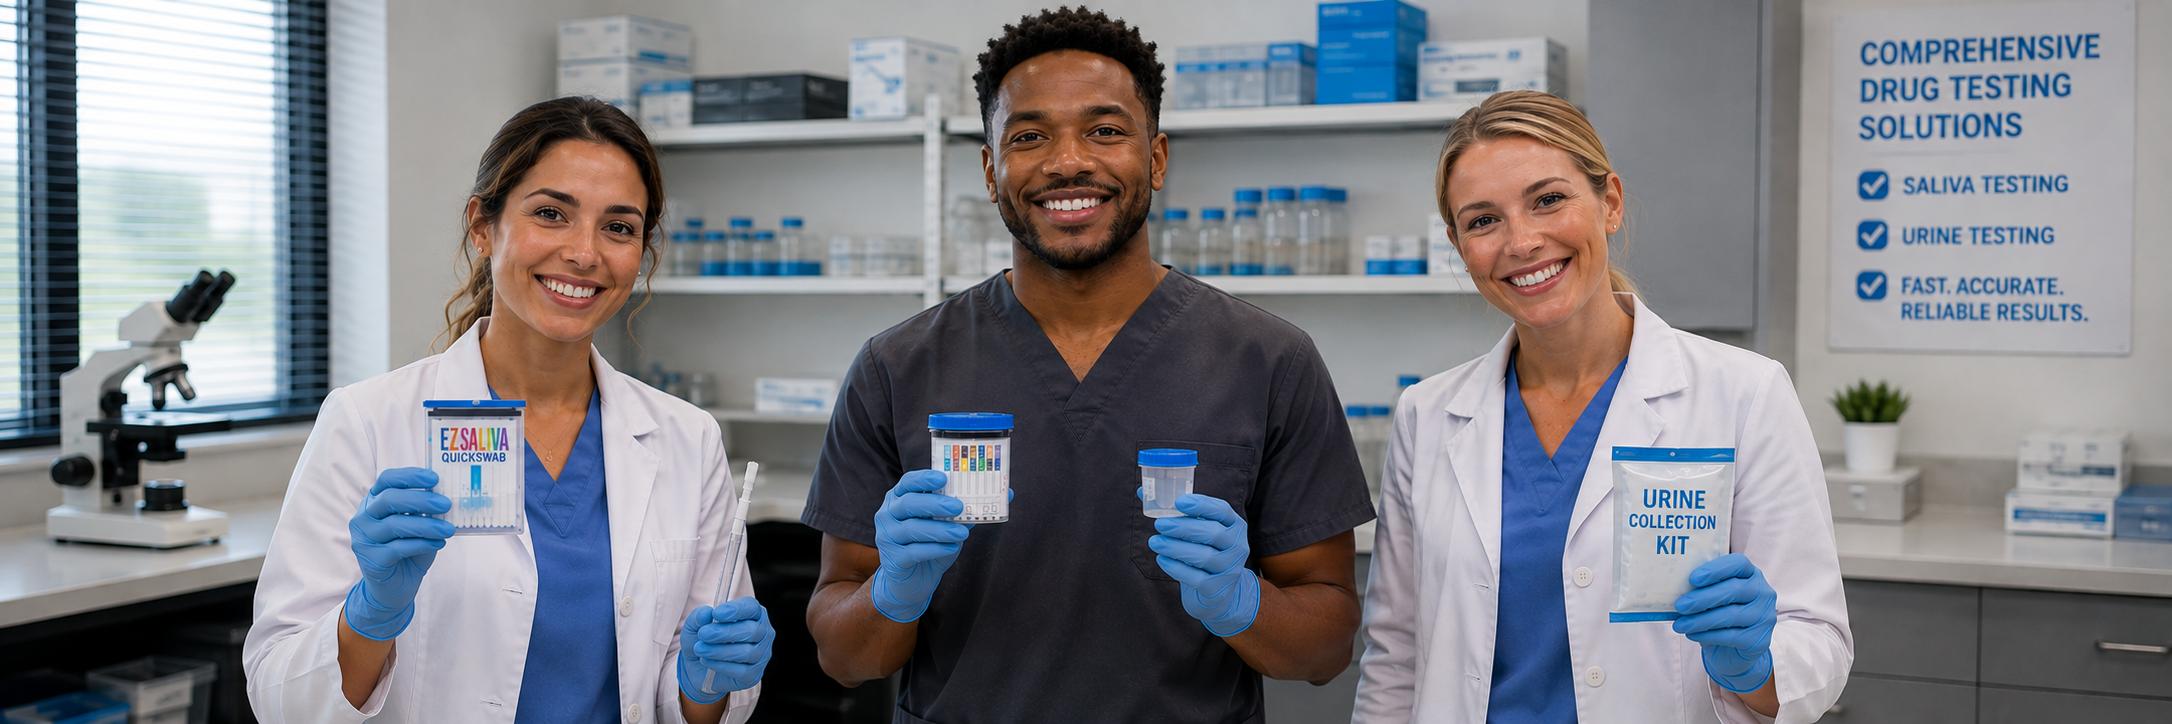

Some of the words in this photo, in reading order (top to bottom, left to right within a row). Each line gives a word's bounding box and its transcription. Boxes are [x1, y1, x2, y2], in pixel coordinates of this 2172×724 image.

[1861, 32, 2100, 65] COMPREHENSIVE
[1861, 77, 1939, 103] DRUG
[1949, 72, 2071, 101] TESTING
[1859, 112, 2022, 141] SOLUTIONS
[1903, 176, 1976, 195] SALIVA
[1981, 175, 2069, 193] TESTING
[1902, 226, 1961, 244] URINE
[1969, 225, 2055, 244] TESTING
[1901, 277, 1952, 294] FAST.
[1956, 277, 2064, 295] ACCURATE.
[1900, 302, 1990, 321] RELIABLE
[1996, 303, 2089, 321] RESULTS.
[442, 452, 506, 462] QUICKSWAB
[1643, 488, 1706, 509] URINE
[1629, 513, 1716, 530] COLLECTION
[1656, 535, 1689, 556] KIT
